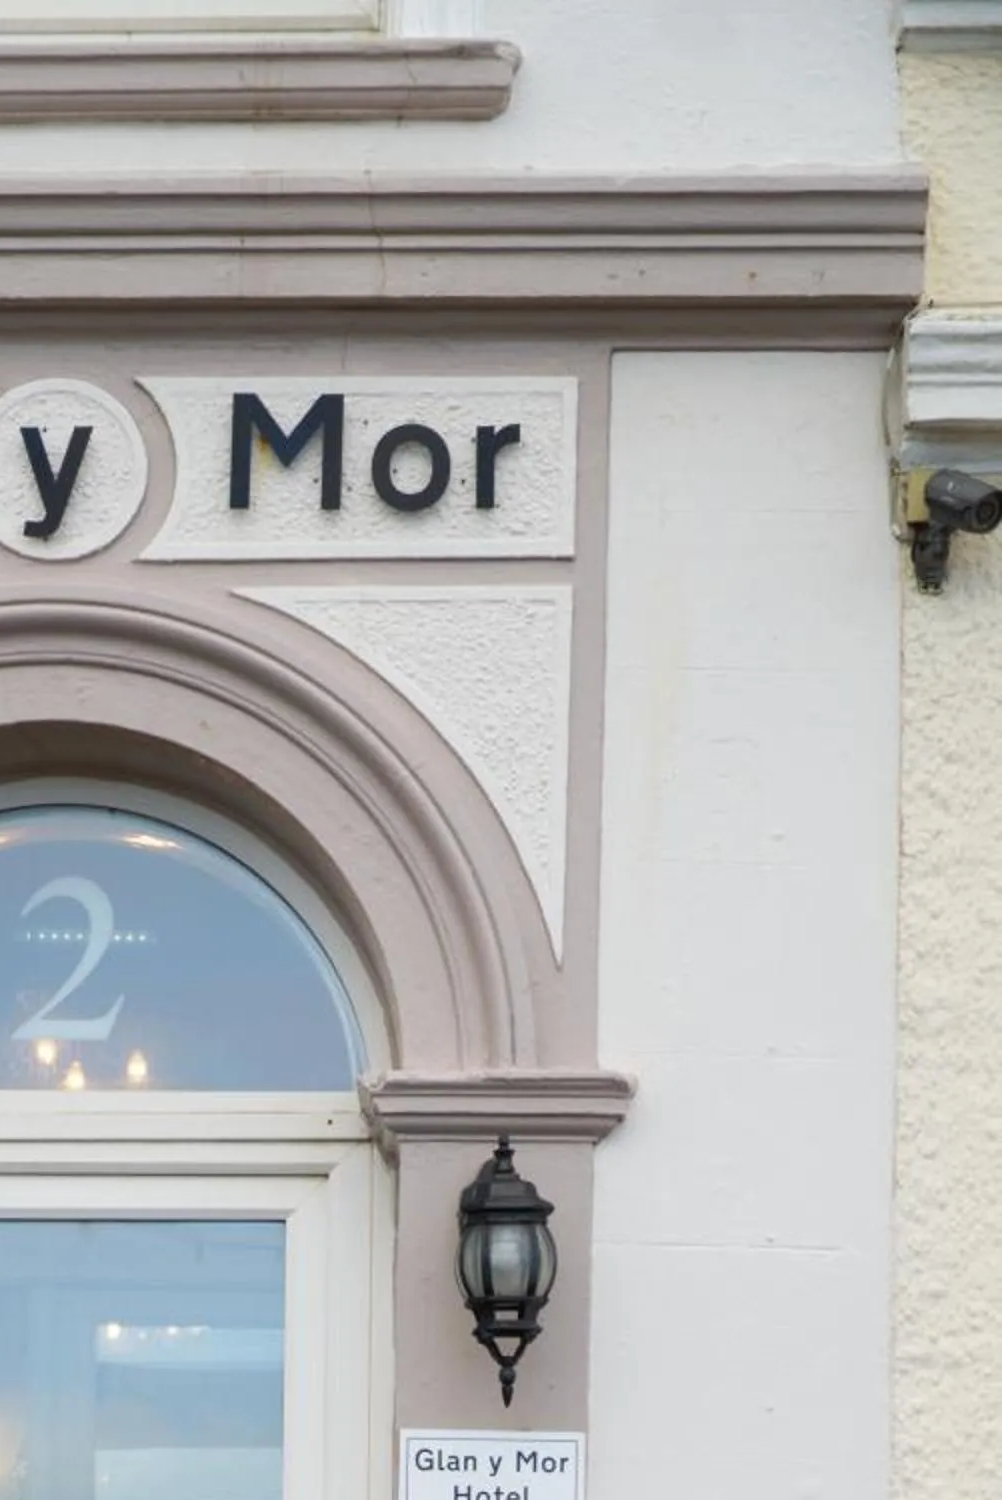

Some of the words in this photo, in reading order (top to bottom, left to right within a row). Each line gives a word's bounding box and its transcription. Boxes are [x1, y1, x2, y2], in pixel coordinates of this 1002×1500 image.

[20, 424, 93, 538] y
[229, 392, 521, 511] Mor
[11, 875, 126, 1041] 2
[414, 1449, 478, 1472] Glan
[489, 1455, 503, 1477] y
[516, 1450, 570, 1474] Mor
